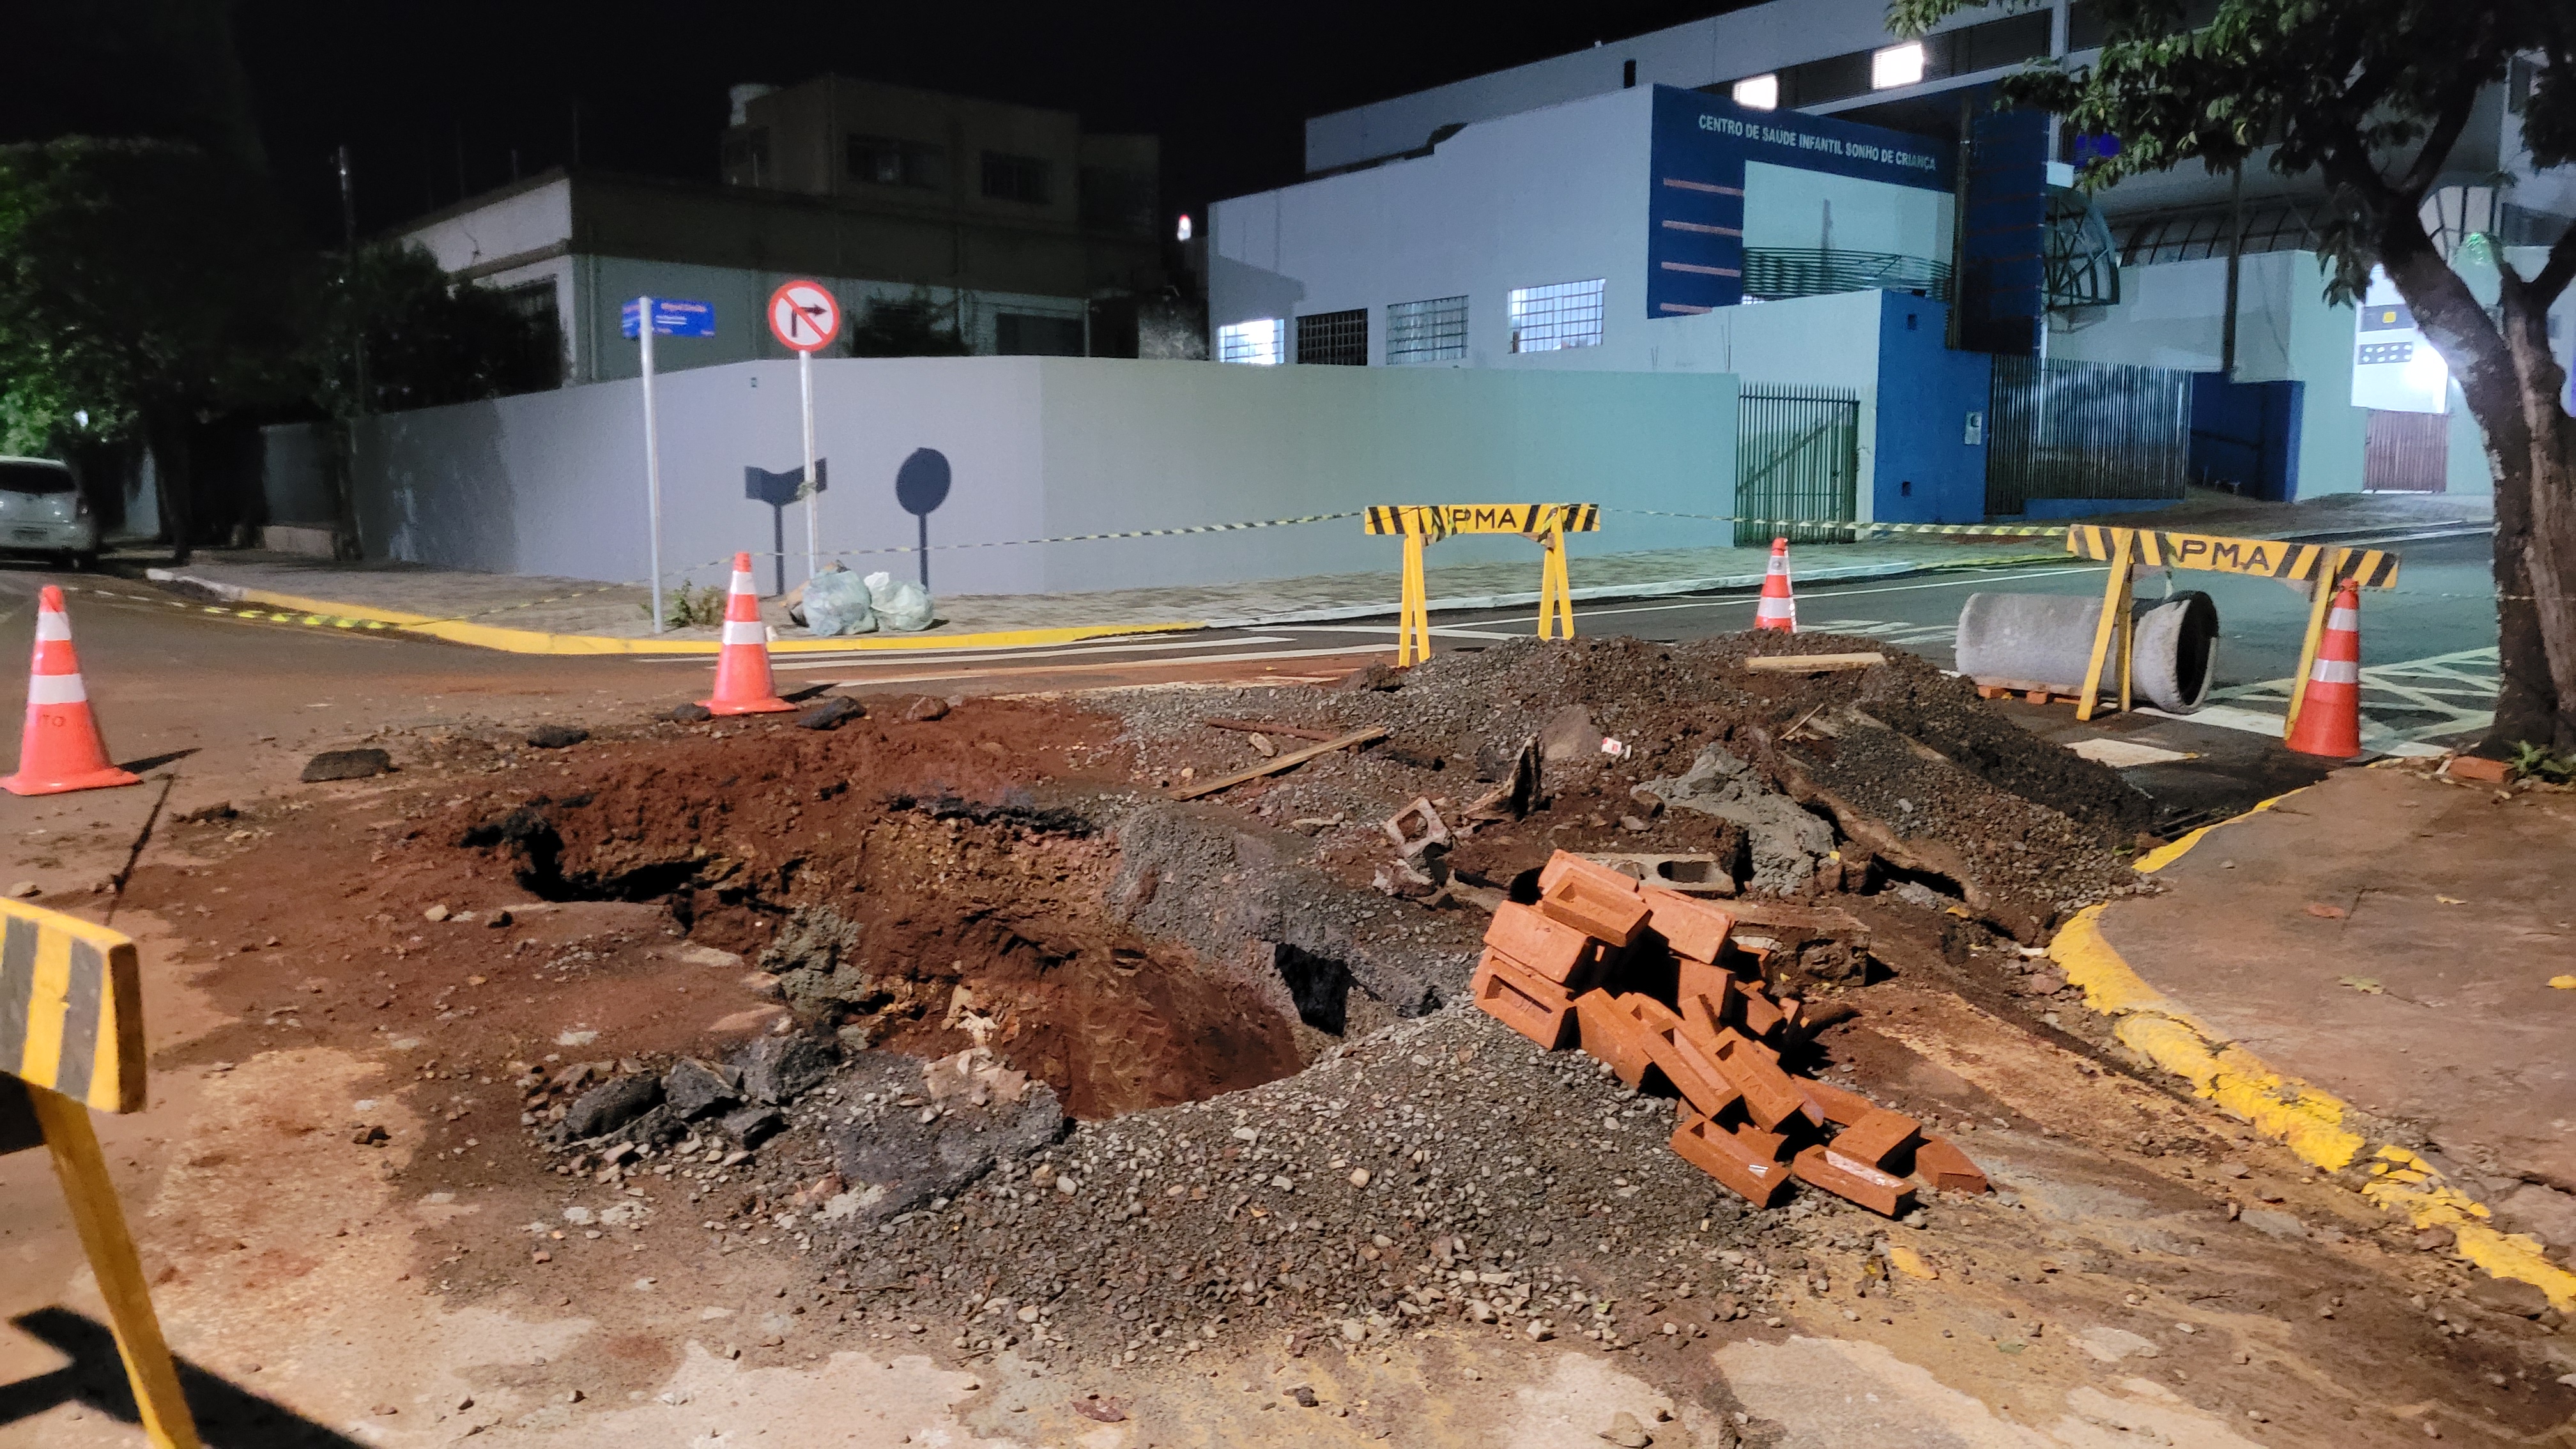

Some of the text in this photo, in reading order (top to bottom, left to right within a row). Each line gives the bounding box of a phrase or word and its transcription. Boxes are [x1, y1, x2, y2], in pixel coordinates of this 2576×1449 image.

[1699, 114, 1936, 172] CENTRO DE SAÚDE INFANTIL SONHO DE CRIANÇA
[1452, 508, 1517, 530] PMA
[2179, 539, 2270, 571] PMA
